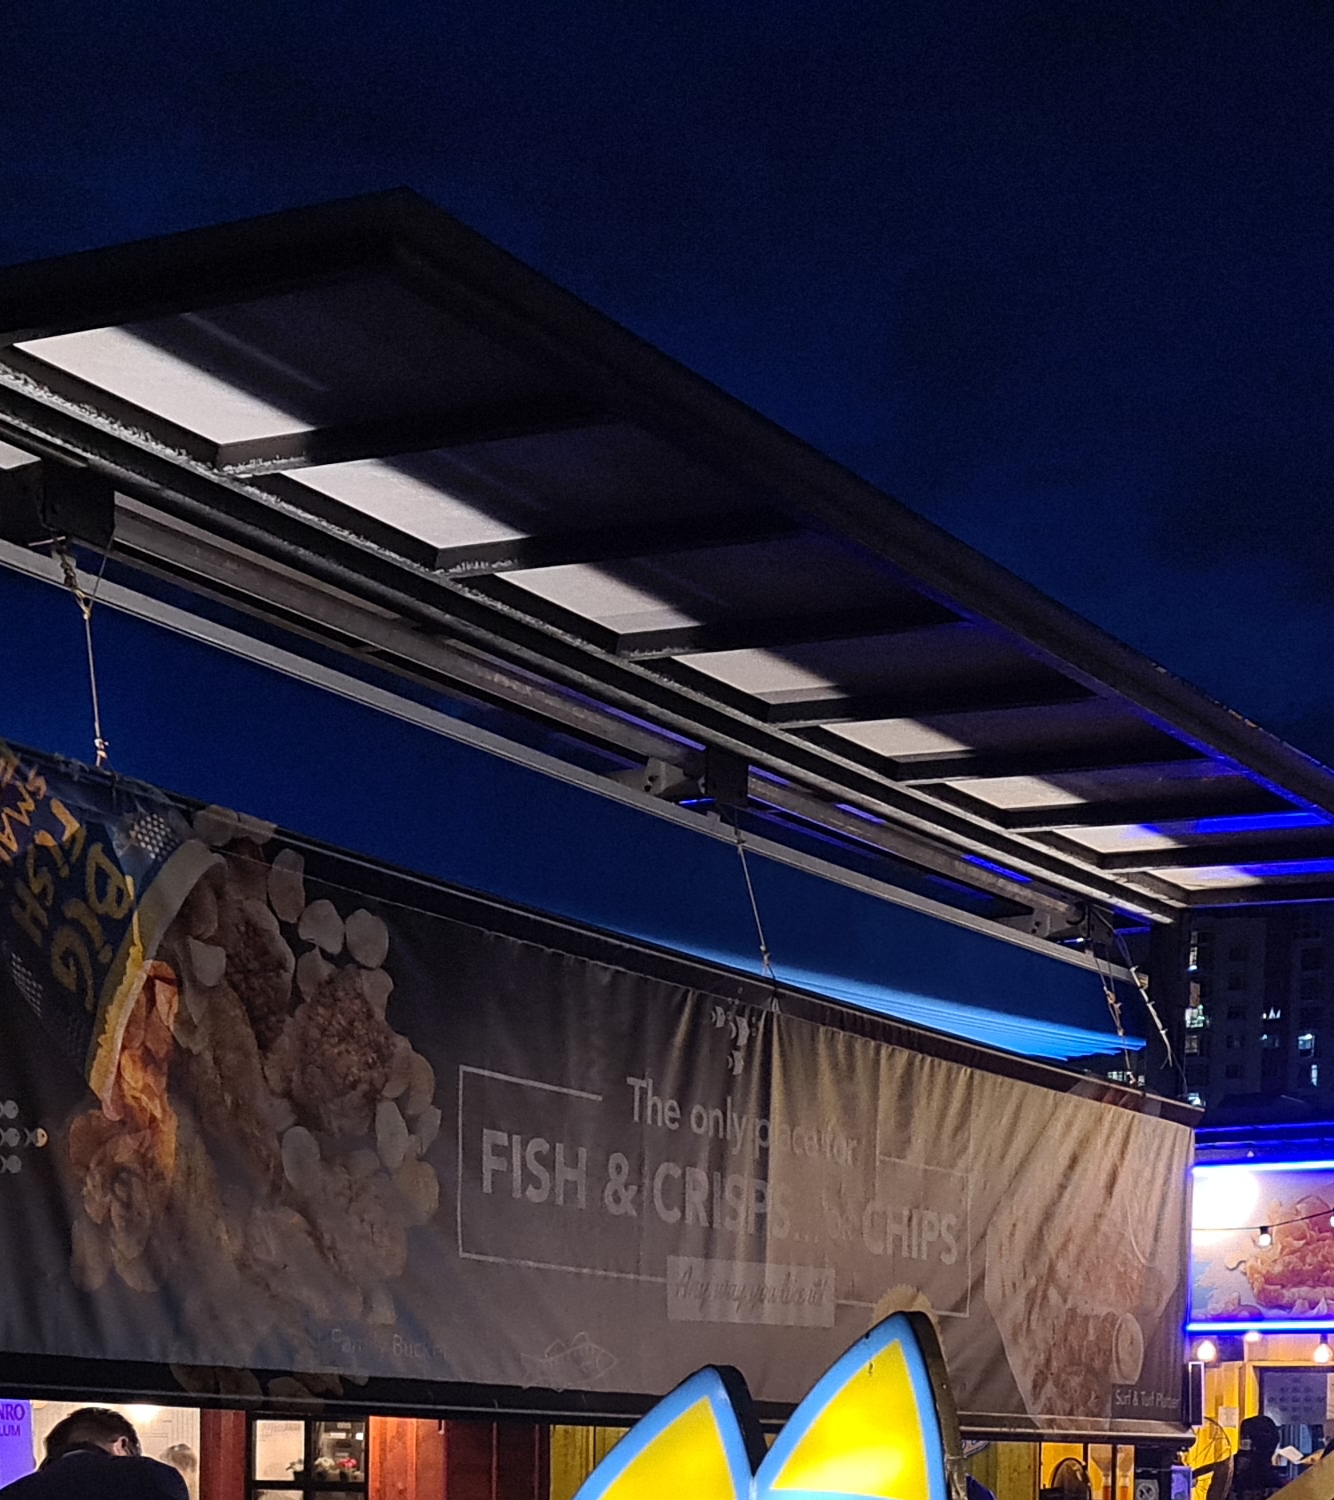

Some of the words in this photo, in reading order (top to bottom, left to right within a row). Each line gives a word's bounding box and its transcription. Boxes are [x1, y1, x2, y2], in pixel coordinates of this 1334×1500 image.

[626, 1076, 681, 1131] The
[690, 1097, 749, 1155] only
[481, 1127, 588, 1210] FISH
[604, 1151, 639, 1217] &
[862, 1200, 958, 1266] CHIPS
